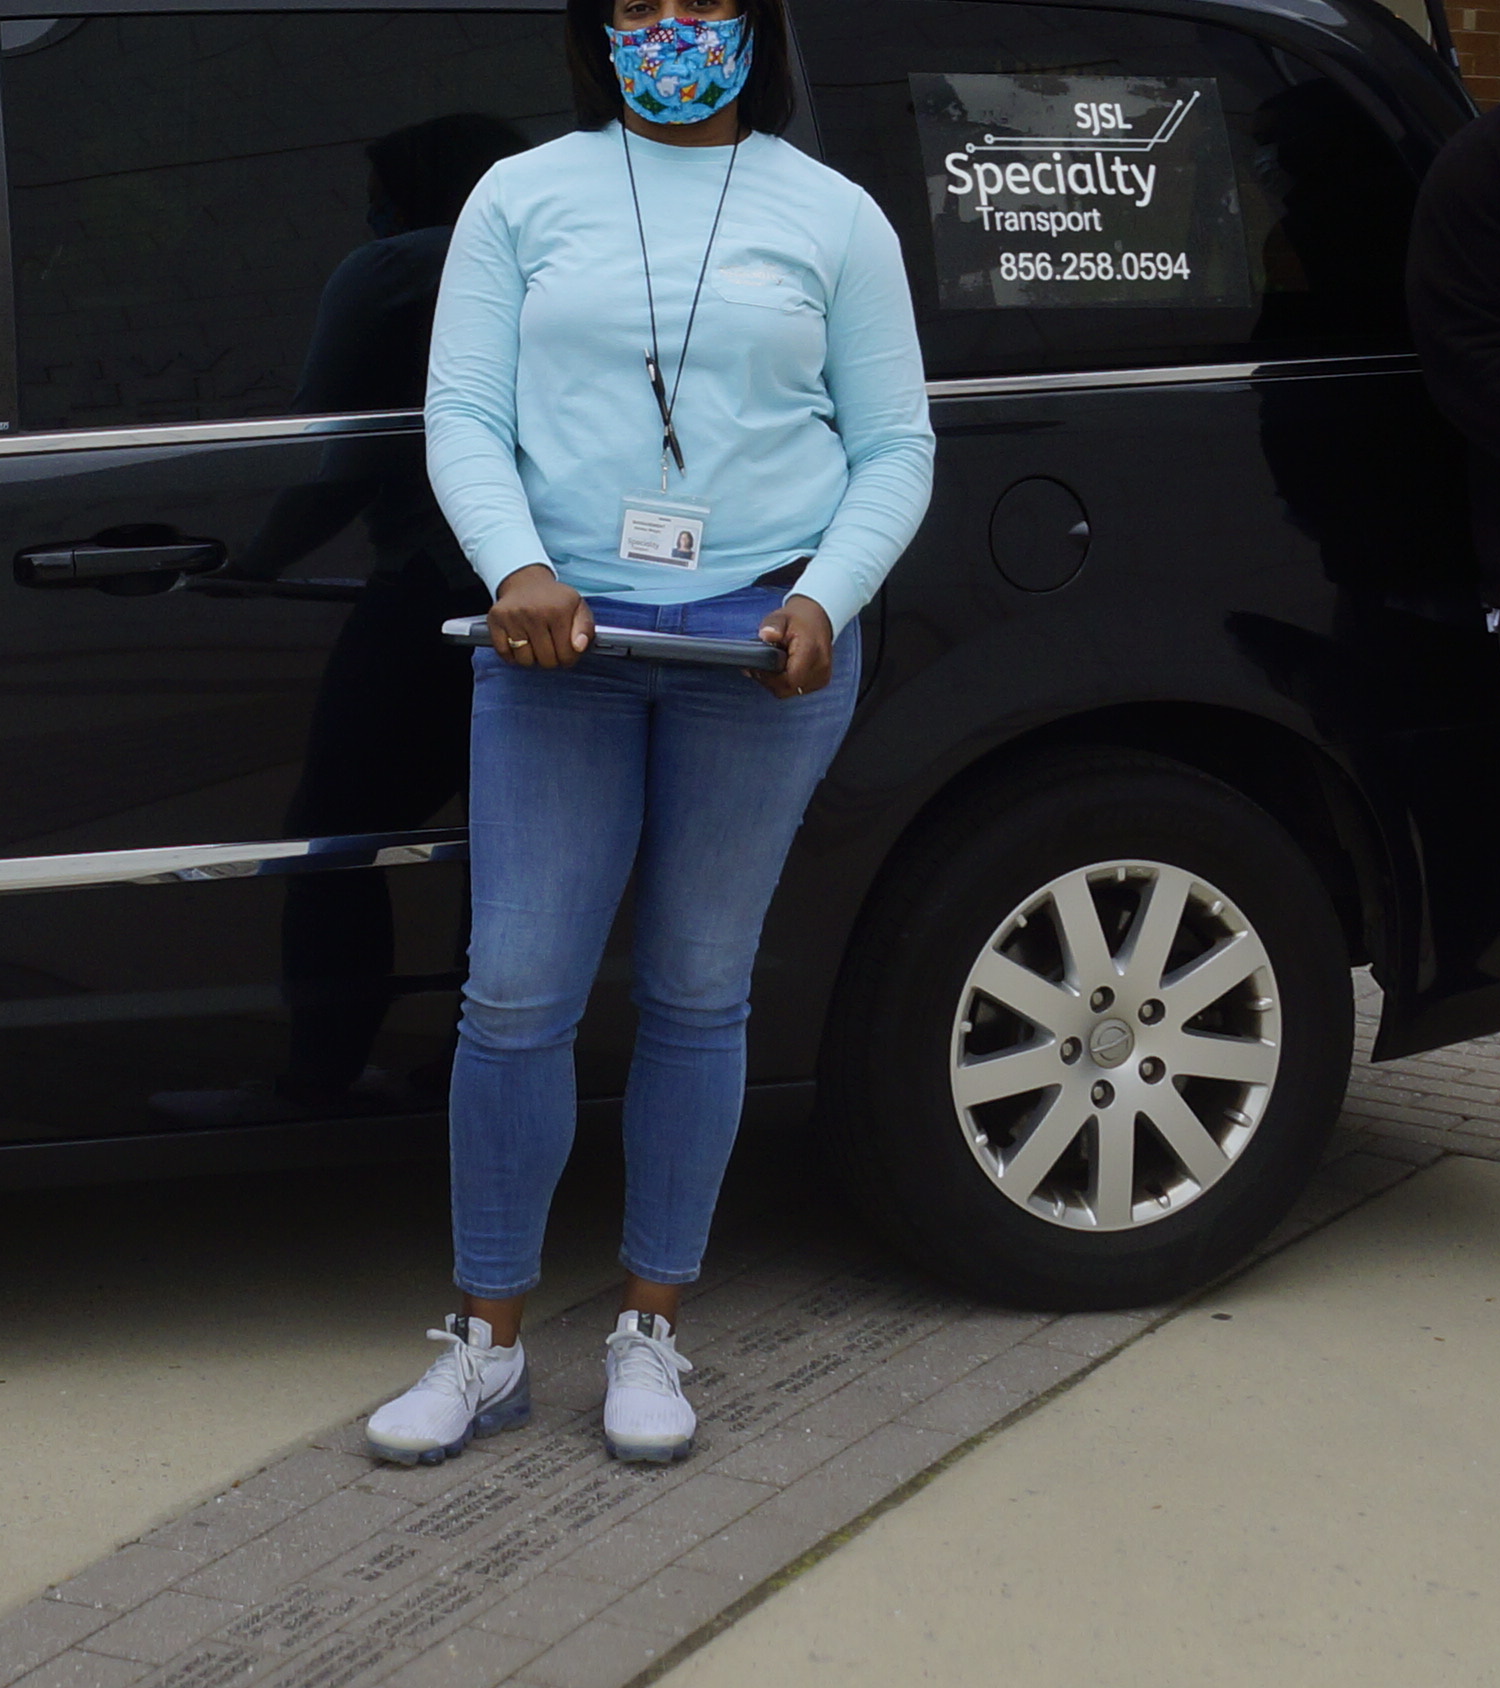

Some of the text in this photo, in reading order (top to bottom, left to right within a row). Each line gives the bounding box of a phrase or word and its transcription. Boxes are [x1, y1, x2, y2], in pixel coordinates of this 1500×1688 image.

[1074, 102, 1132, 136] SJSL
[945, 152, 1157, 208] Specialty
[976, 205, 1102, 237] Transport
[1000, 252, 1190, 282] 856.258.0594
